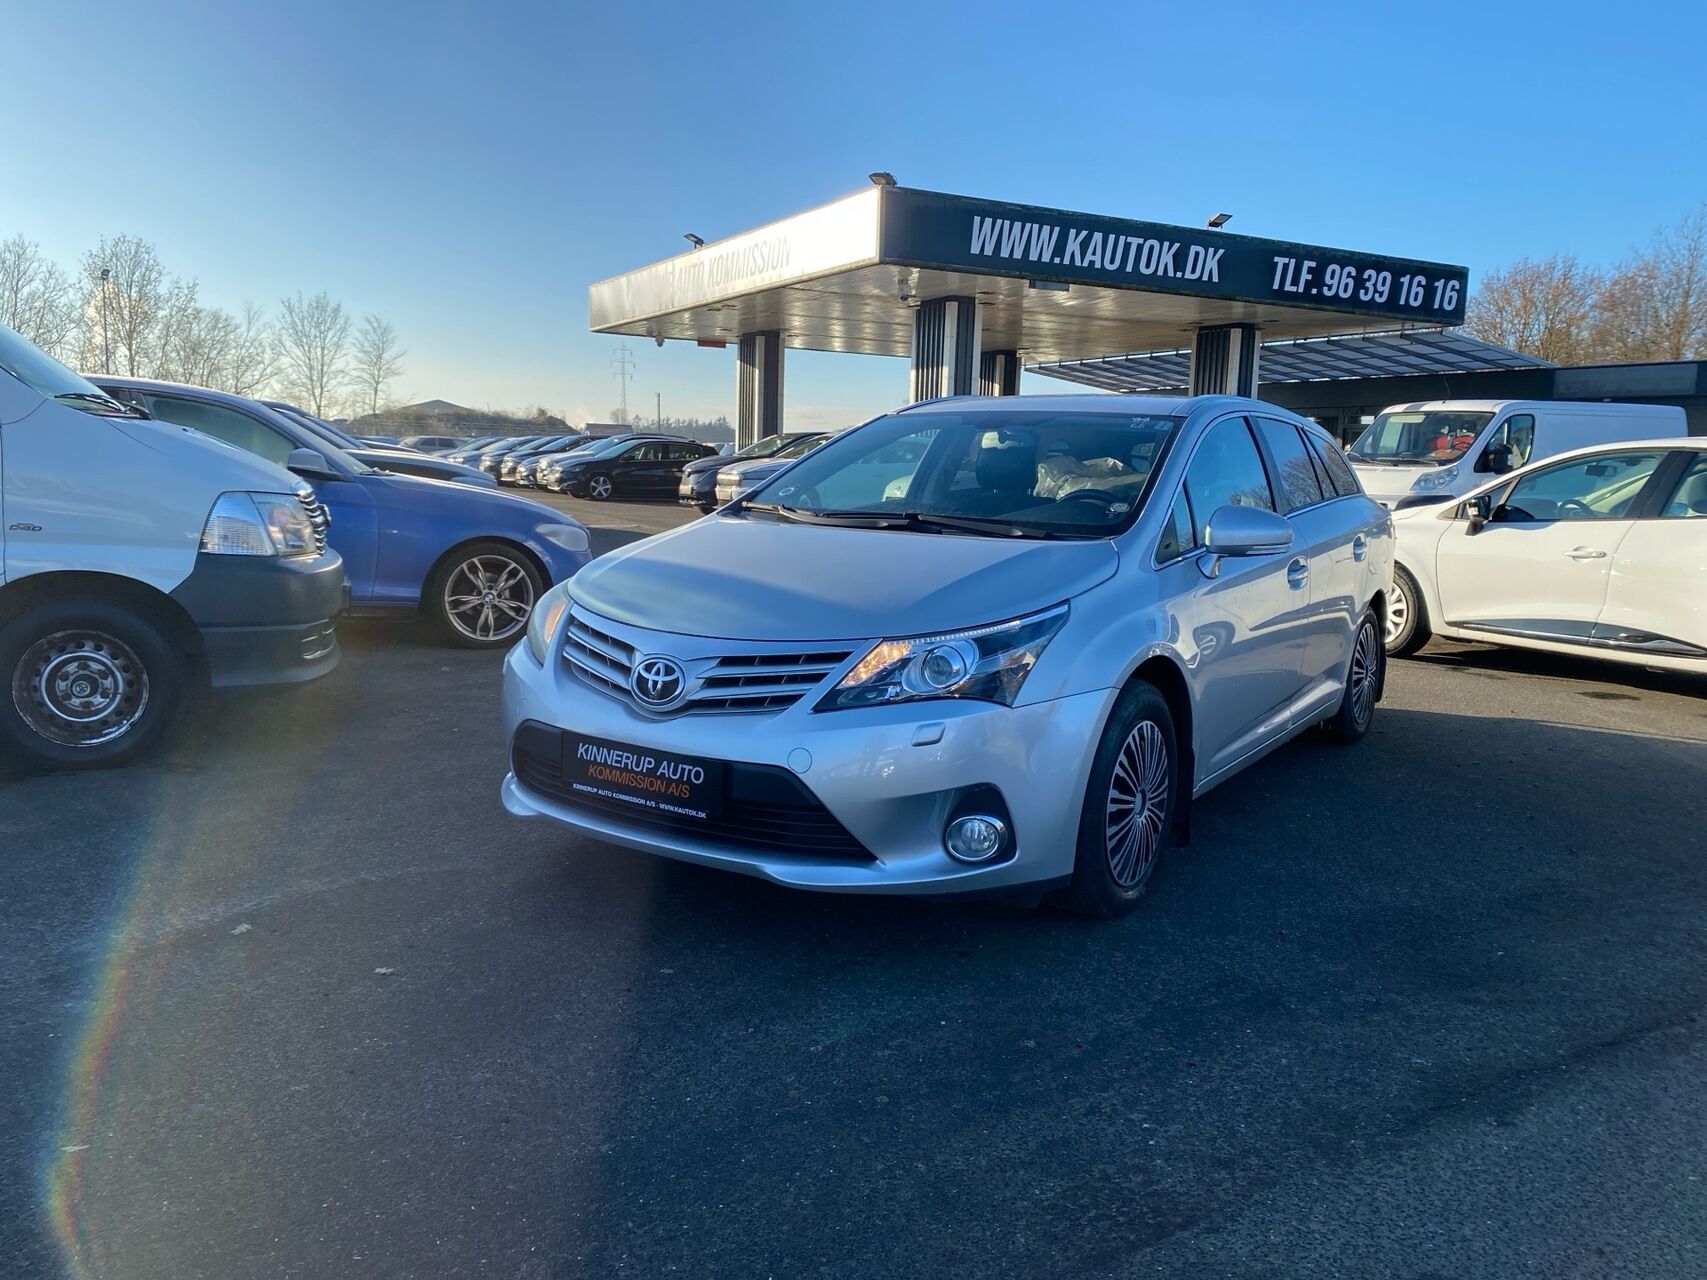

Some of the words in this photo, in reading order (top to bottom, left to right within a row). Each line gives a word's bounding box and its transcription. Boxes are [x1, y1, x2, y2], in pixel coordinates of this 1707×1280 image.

[675, 260, 705, 295] AUTO
[706, 234, 792, 288] KOMMISSION
[970, 215, 1226, 283] WWW.KAUTOK.DK
[1272, 256, 1318, 295] TLF.
[1322, 263, 1357, 299] 96
[1359, 268, 1392, 303] 39
[1399, 274, 1427, 308] 16
[1433, 279, 1461, 311] 16
[577, 743, 655, 773] KINNERUP
[657, 761, 704, 784] AUTO
[588, 765, 666, 793] KOMMISSION
[668, 784, 690, 798] A/S
[573, 783, 598, 793] KINNERUP
[598, 789, 613, 797] AUTO
[613, 793, 646, 805] KOMMISSION
[659, 803, 706, 819] WWW.KAUTOK.DK
